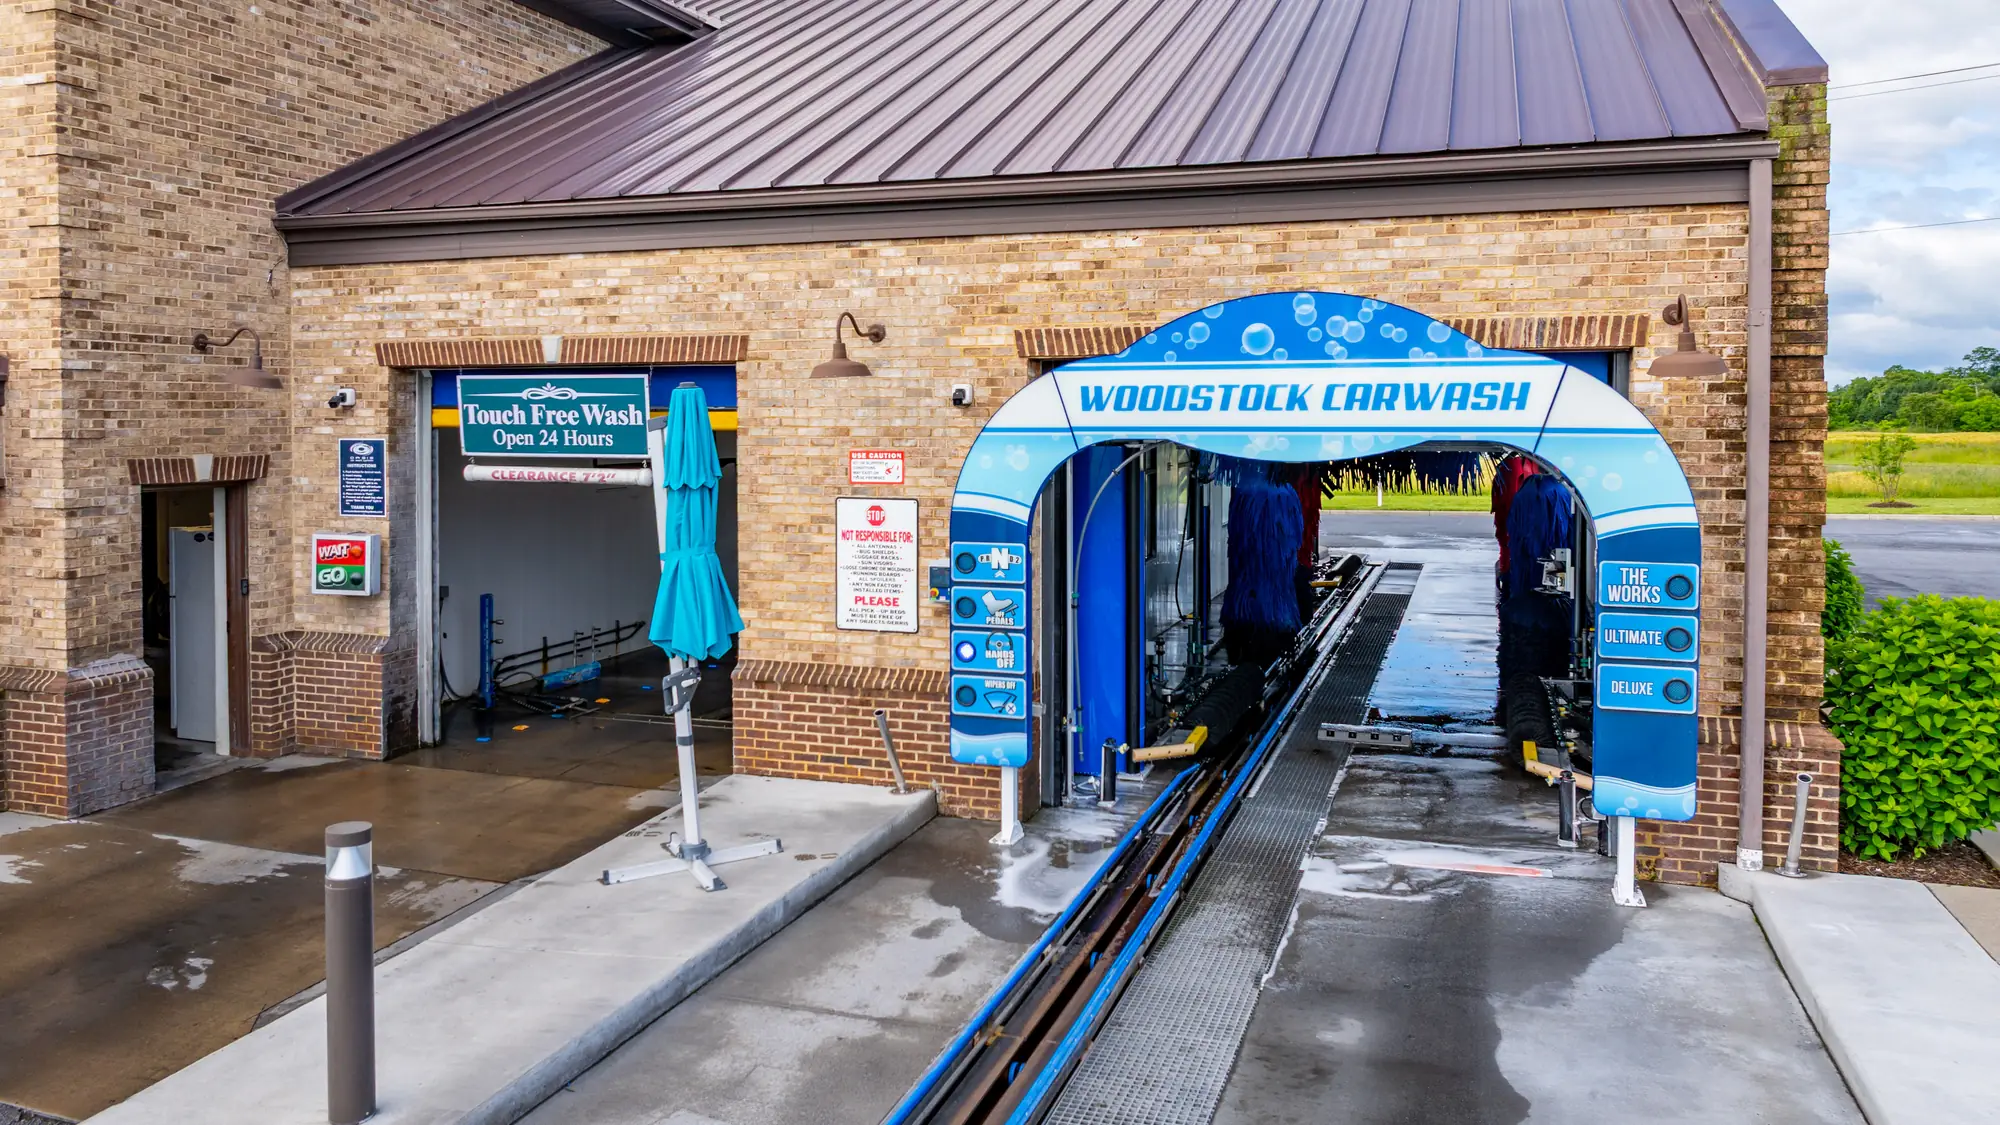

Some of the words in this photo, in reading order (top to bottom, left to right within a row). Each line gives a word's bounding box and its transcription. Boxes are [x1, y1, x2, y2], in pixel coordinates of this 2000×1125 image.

[1080, 384, 1314, 412] WOODSTOCK
[1322, 382, 1531, 410] CARWASH
[464, 404, 527, 426] Touch
[530, 404, 580, 426] Free
[580, 404, 644, 426] Wash
[493, 429, 534, 449] Open
[540, 430, 558, 446] 24
[564, 430, 614, 446] Hours
[491, 470, 576, 482] CLEARANCE
[868, 510, 885, 520] STOP
[842, 530, 854, 541] NOT
[856, 530, 897, 542] RESPONSIBLE
[318, 543, 350, 560] WAIT
[991, 548, 1009, 570] N
[318, 567, 347, 586] GO
[1620, 567, 1649, 585] THE
[854, 596, 900, 606] PLEASE
[1608, 585, 1660, 603] WORKS
[986, 616, 1014, 625] PEDALS
[1604, 629, 1662, 645] ULTIMATE
[985, 650, 1014, 659] HANDS
[997, 659, 1014, 668] OFF
[984, 680, 1005, 689] WIPERS
[1007, 681, 1016, 690] OFF
[1611, 681, 1654, 695] DELUXE
